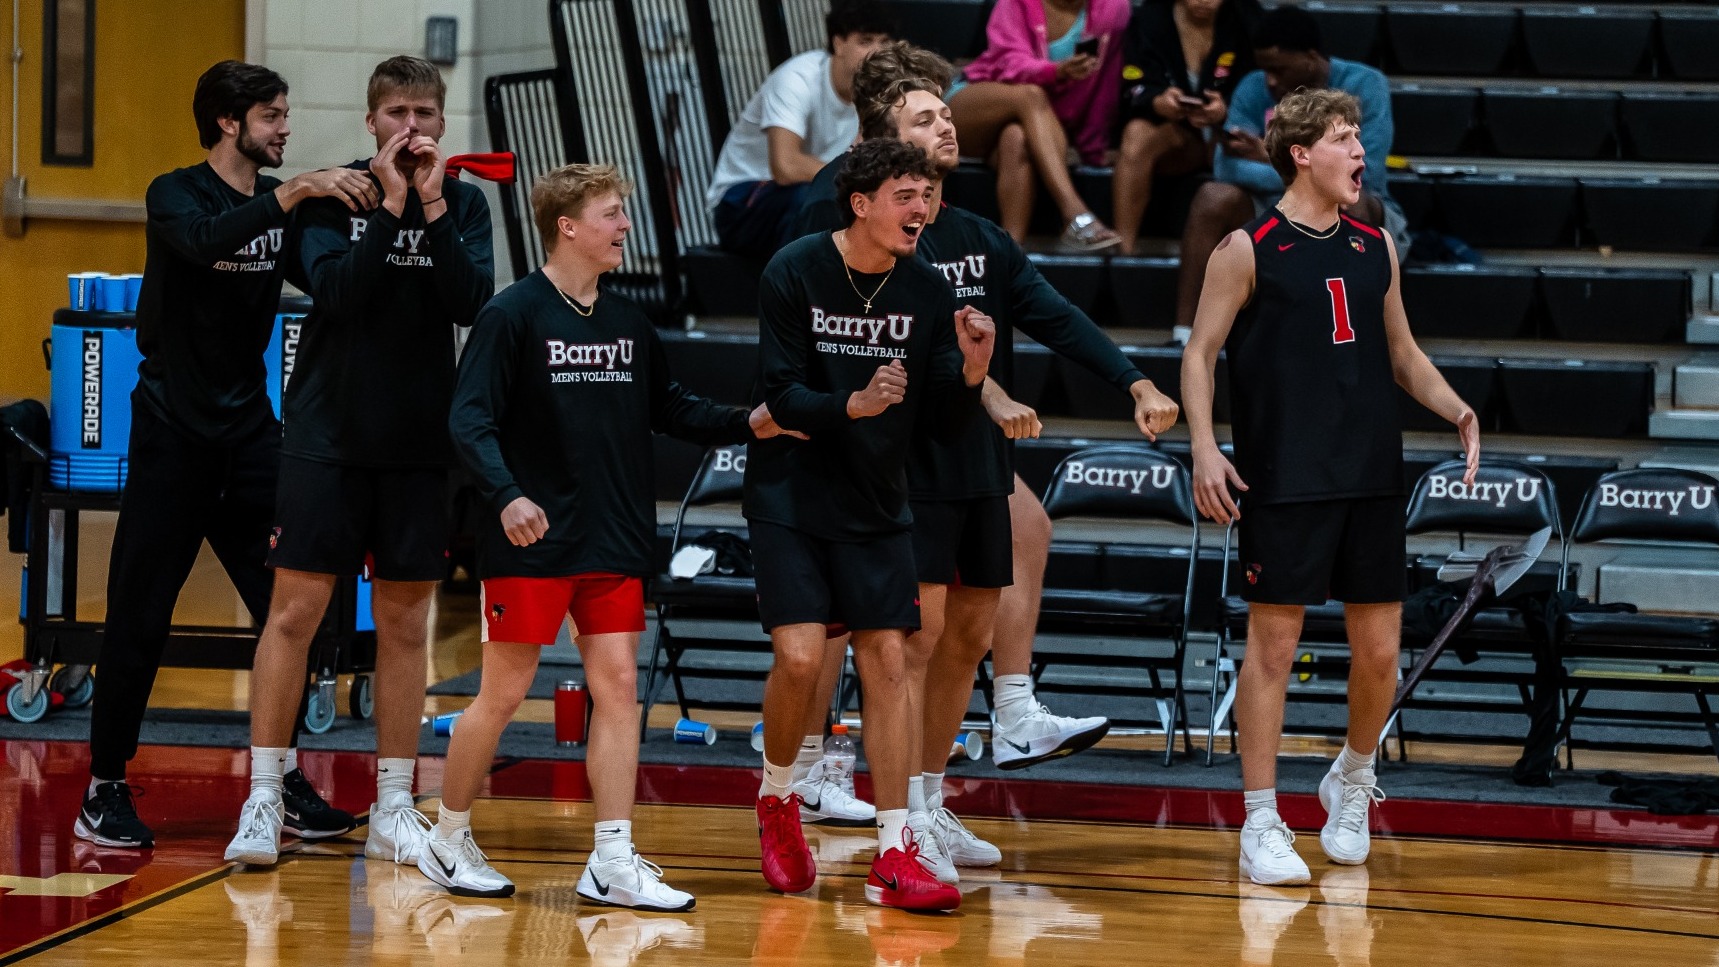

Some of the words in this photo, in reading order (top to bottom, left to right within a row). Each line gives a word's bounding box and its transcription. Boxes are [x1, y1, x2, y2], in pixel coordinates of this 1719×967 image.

[1325, 277, 1356, 345] 1
[838, 344, 907, 359] VOLLEYBALL
[84, 337, 100, 443] POWERADE
[581, 371, 633, 382] VOLLEYBALL
[1064, 461, 1148, 494] Barry
[1428, 475, 1513, 508] Barry
[1599, 483, 1686, 516] Barry
